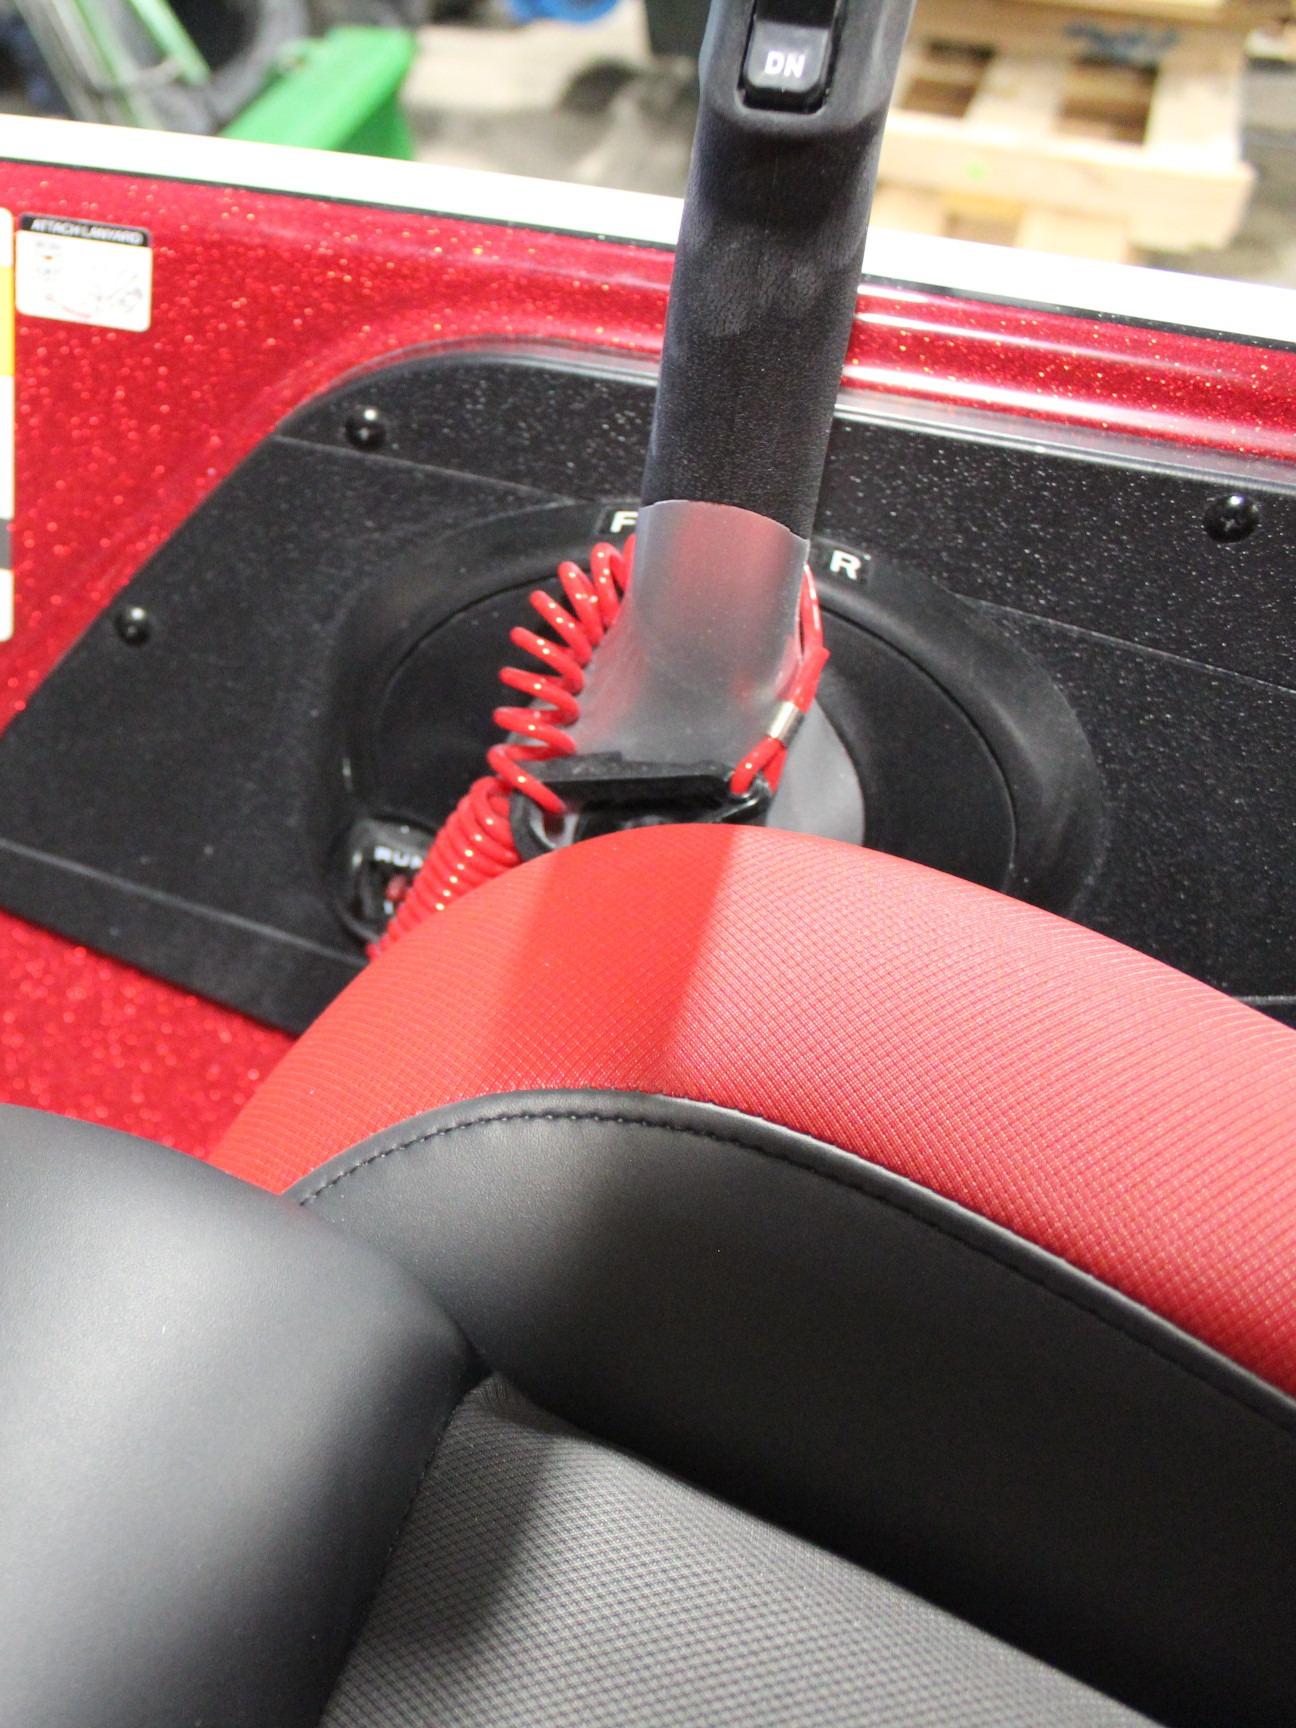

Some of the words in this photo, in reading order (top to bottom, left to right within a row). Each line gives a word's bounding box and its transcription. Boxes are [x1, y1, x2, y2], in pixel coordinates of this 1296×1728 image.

[764, 48, 807, 78] DN
[610, 511, 639, 533] F
[829, 550, 861, 580] R
